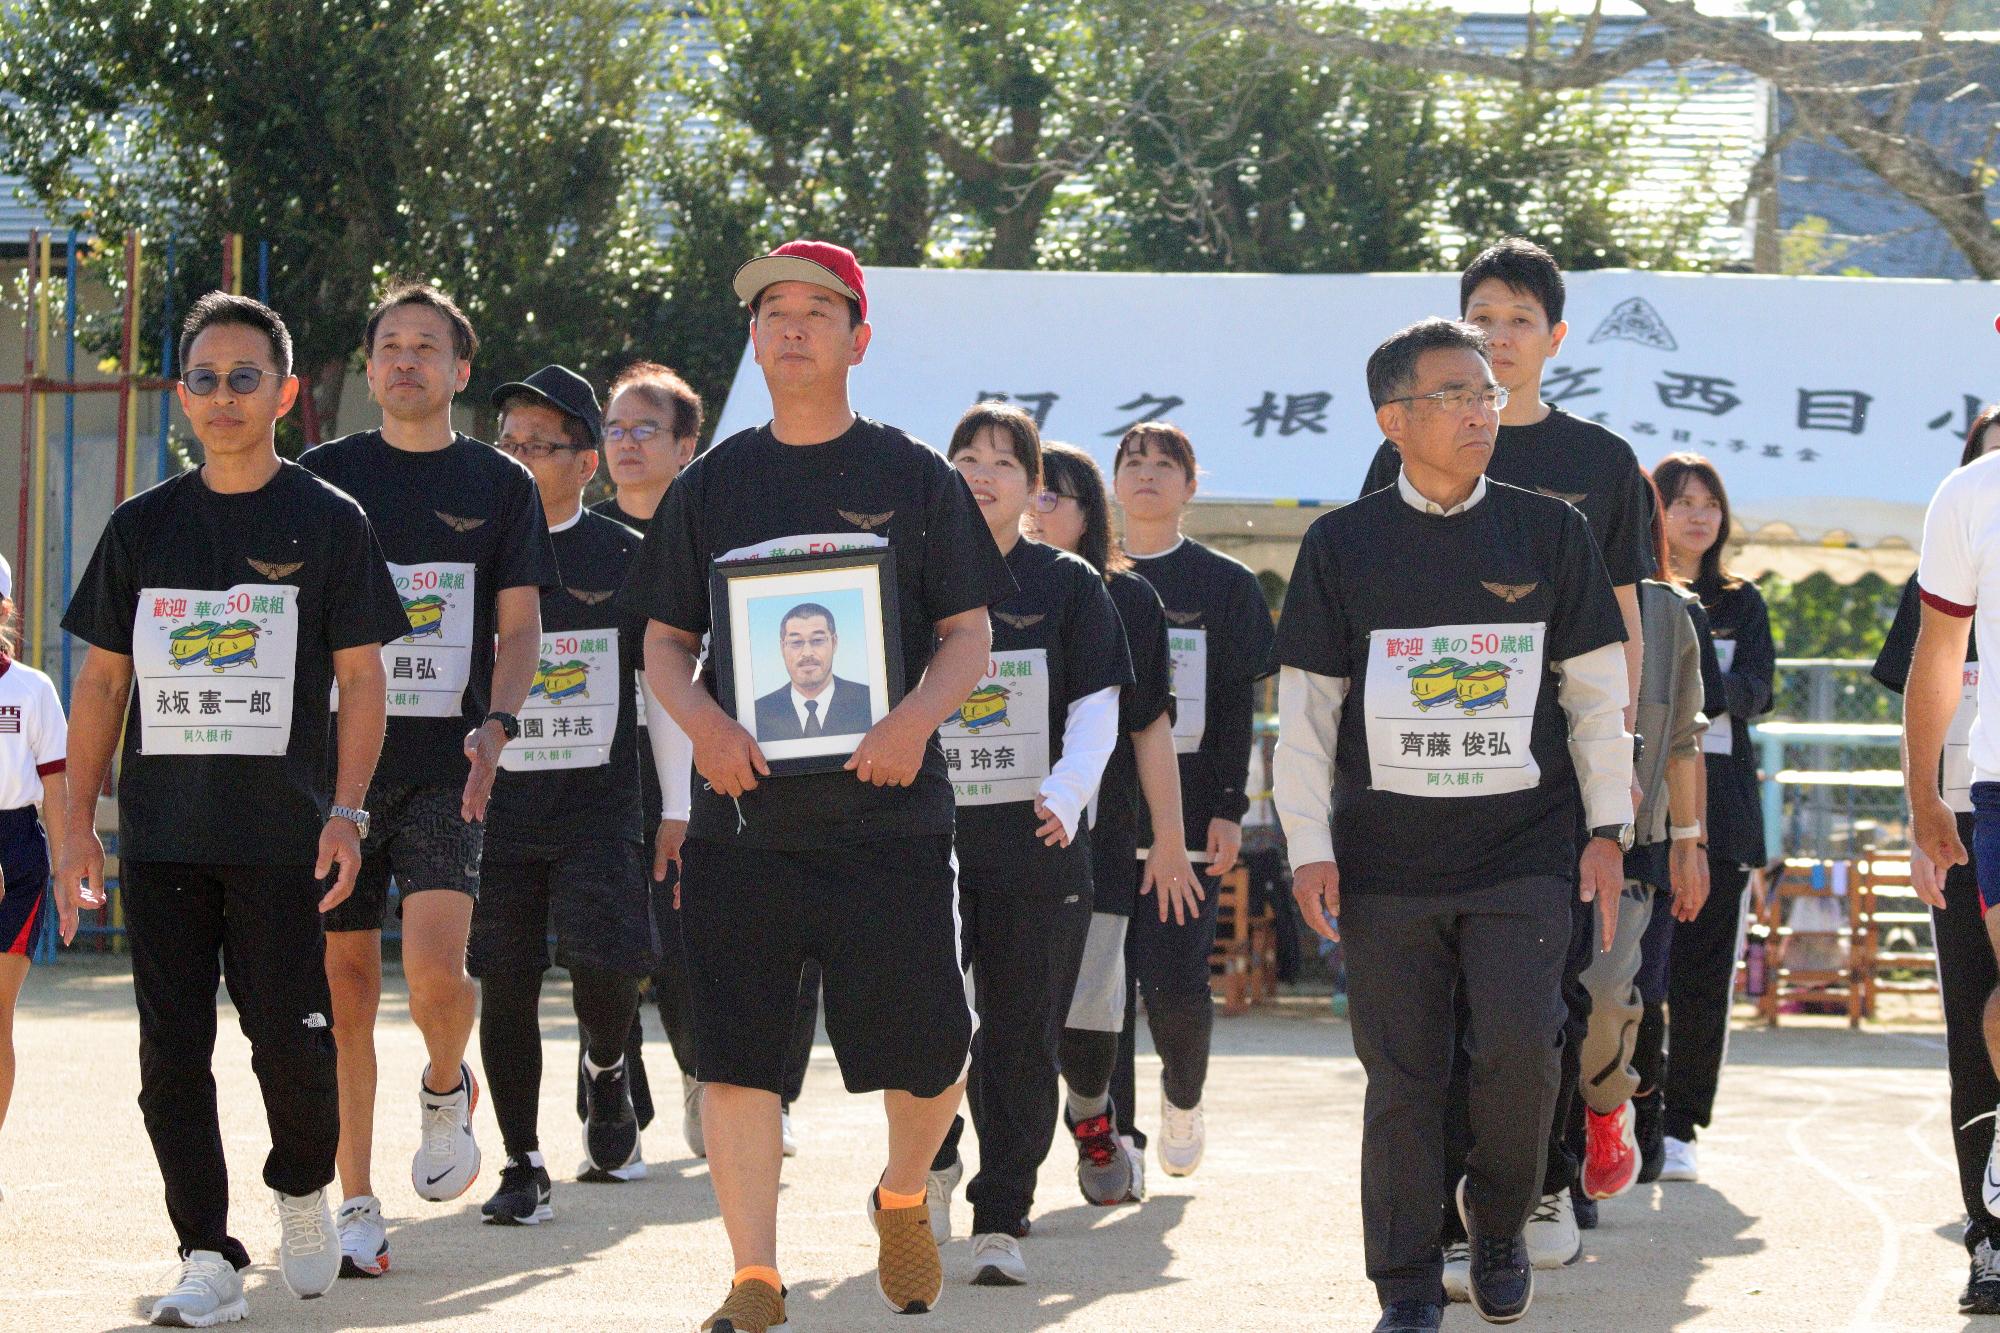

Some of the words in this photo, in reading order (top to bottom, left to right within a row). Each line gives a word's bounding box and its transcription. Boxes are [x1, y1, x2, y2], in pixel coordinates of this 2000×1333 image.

[390, 570, 465, 591] の50歳組
[153, 597, 187, 618] 歓迎
[193, 592, 285, 619] 華の50歳組
[1386, 637, 1424, 658] 歓迎
[1431, 633, 1535, 655] 華の50歳組
[392, 656, 437, 680] 昌弘
[156, 689, 191, 715] 永坂
[198, 689, 272, 716] 憲一郎
[183, 728, 233, 743] 阿久根市
[552, 716, 594, 738] 洋志
[524, 749, 573, 762] 阿久根市
[1400, 731, 1451, 758] 齊藤
[1462, 731, 1512, 758] 俊弘
[970, 745, 1016, 771] 玲奈
[1426, 771, 1485, 786] 阿久根市
